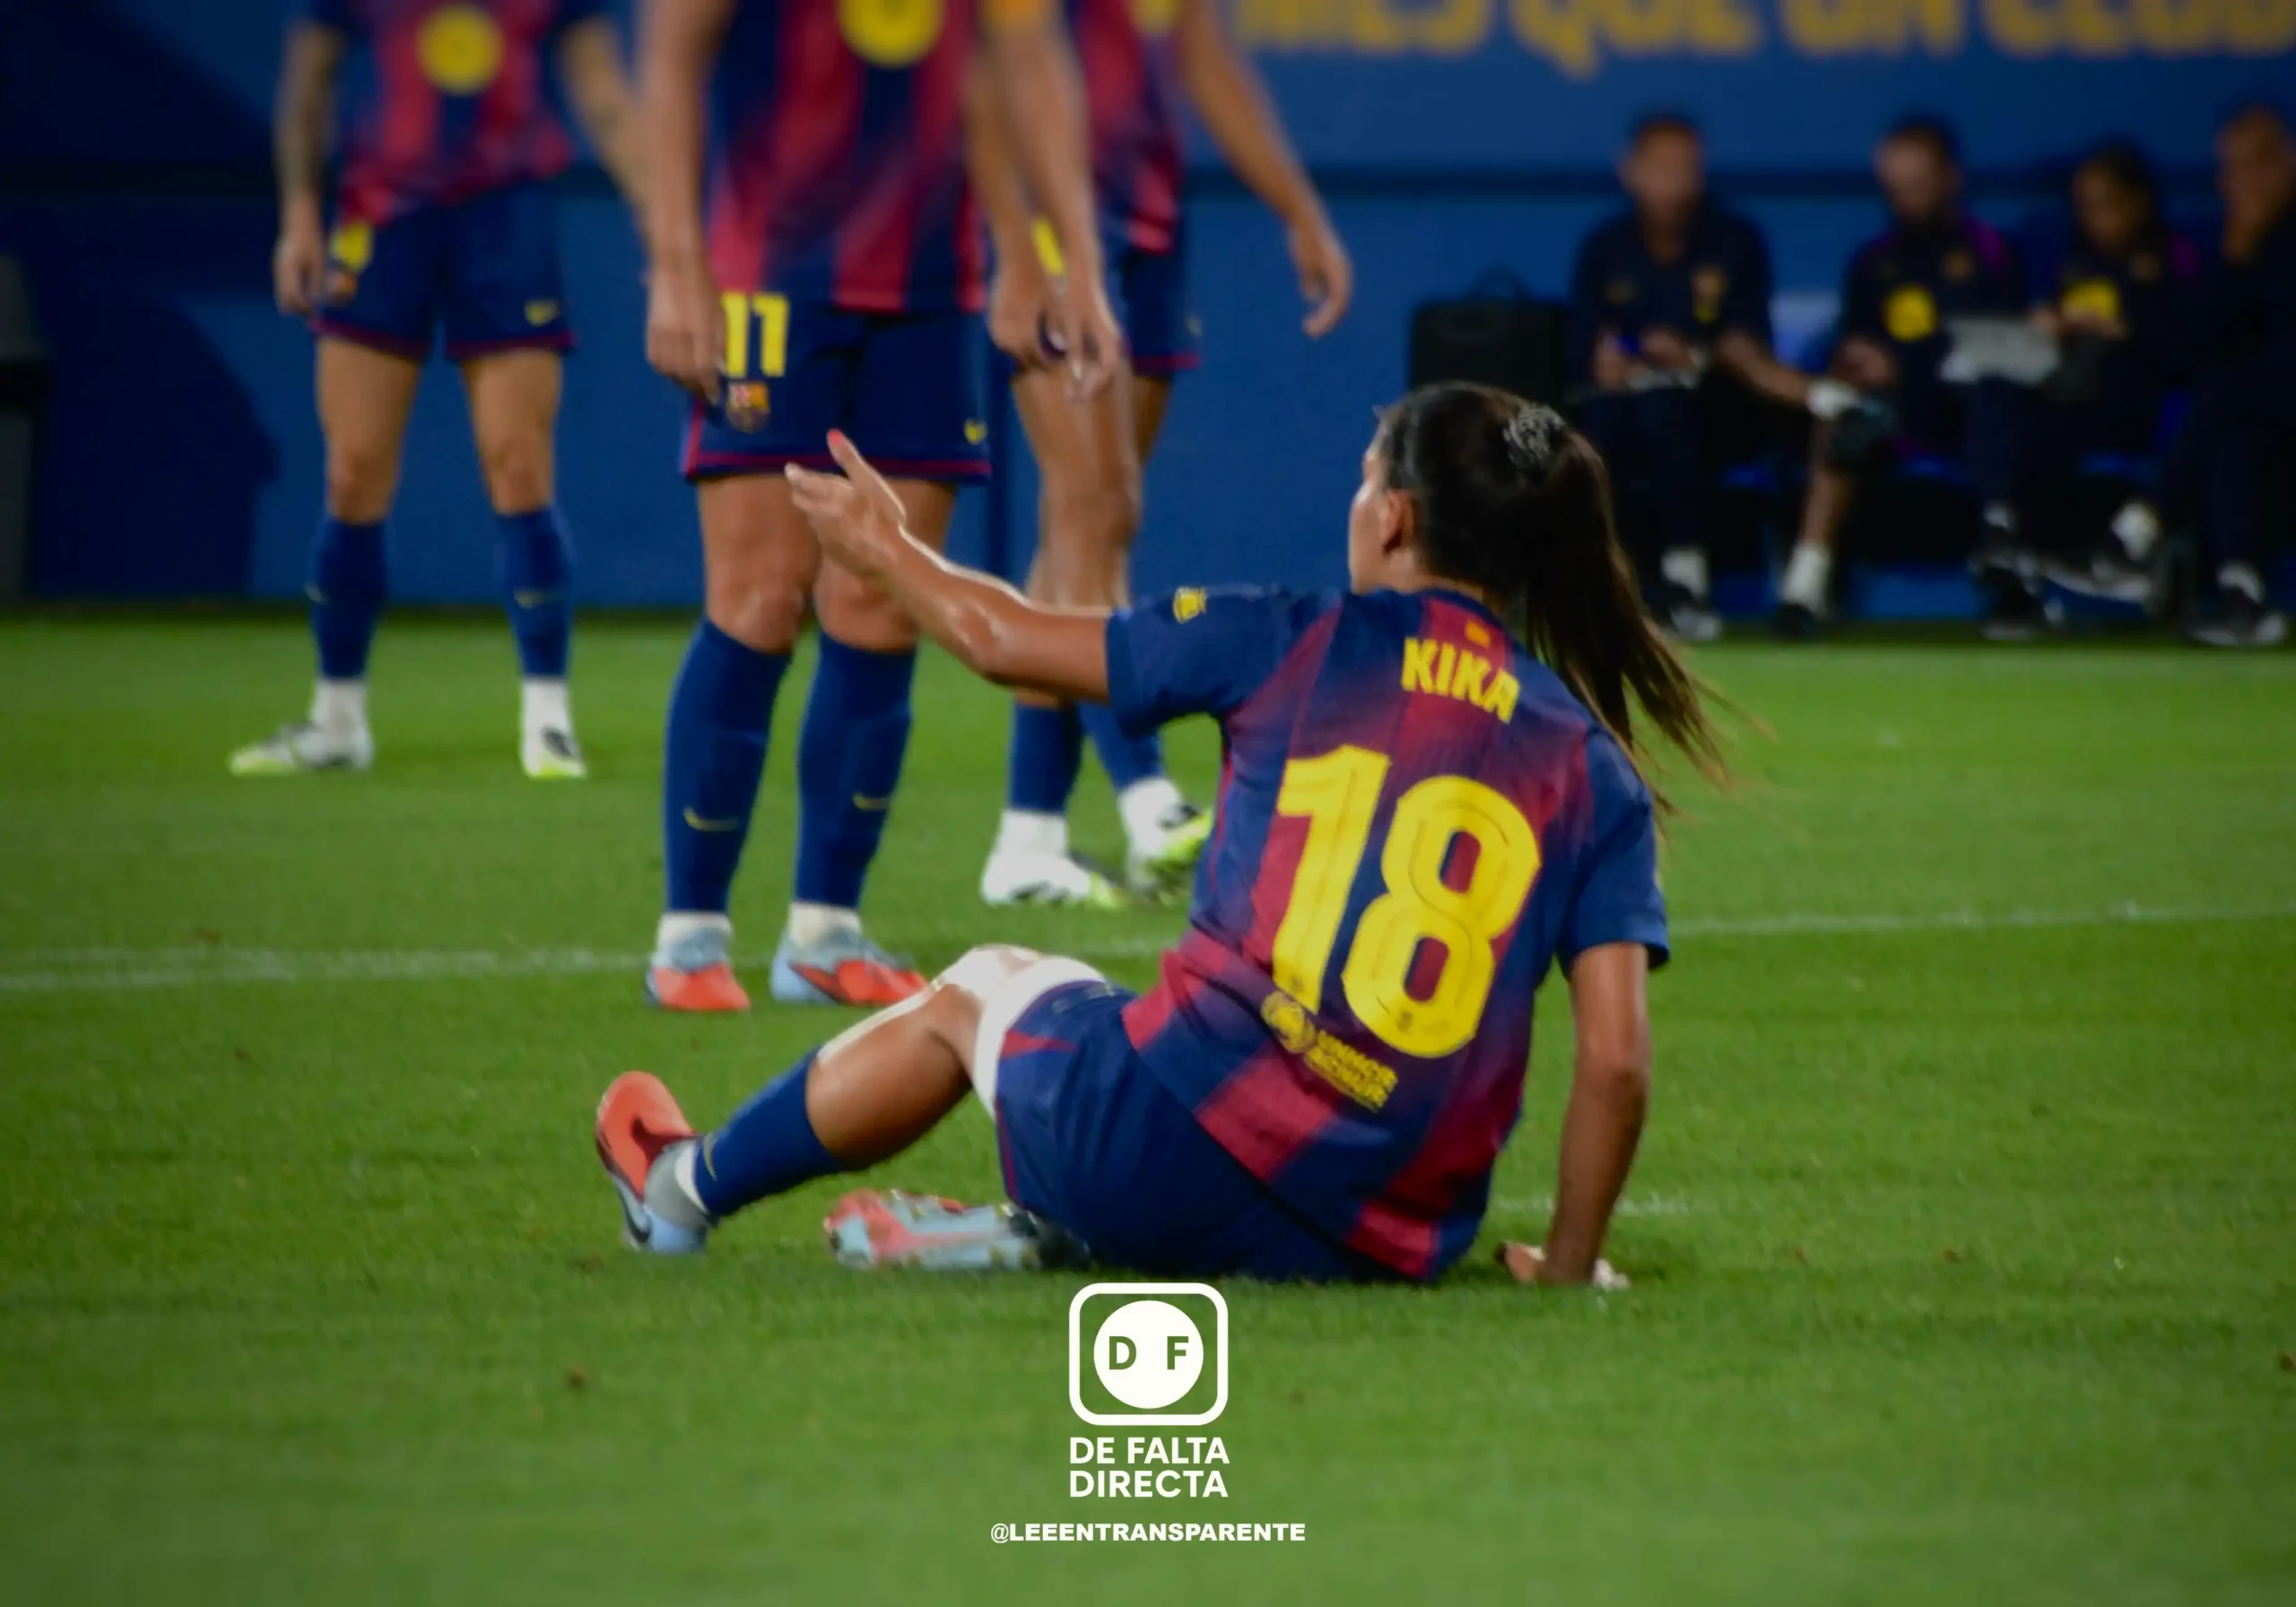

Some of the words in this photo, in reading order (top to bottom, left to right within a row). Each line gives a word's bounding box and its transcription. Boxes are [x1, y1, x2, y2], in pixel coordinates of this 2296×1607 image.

[720, 289, 789, 378] 11
[1401, 636, 1521, 725] KIKA
[1273, 743, 1541, 1058] 18
